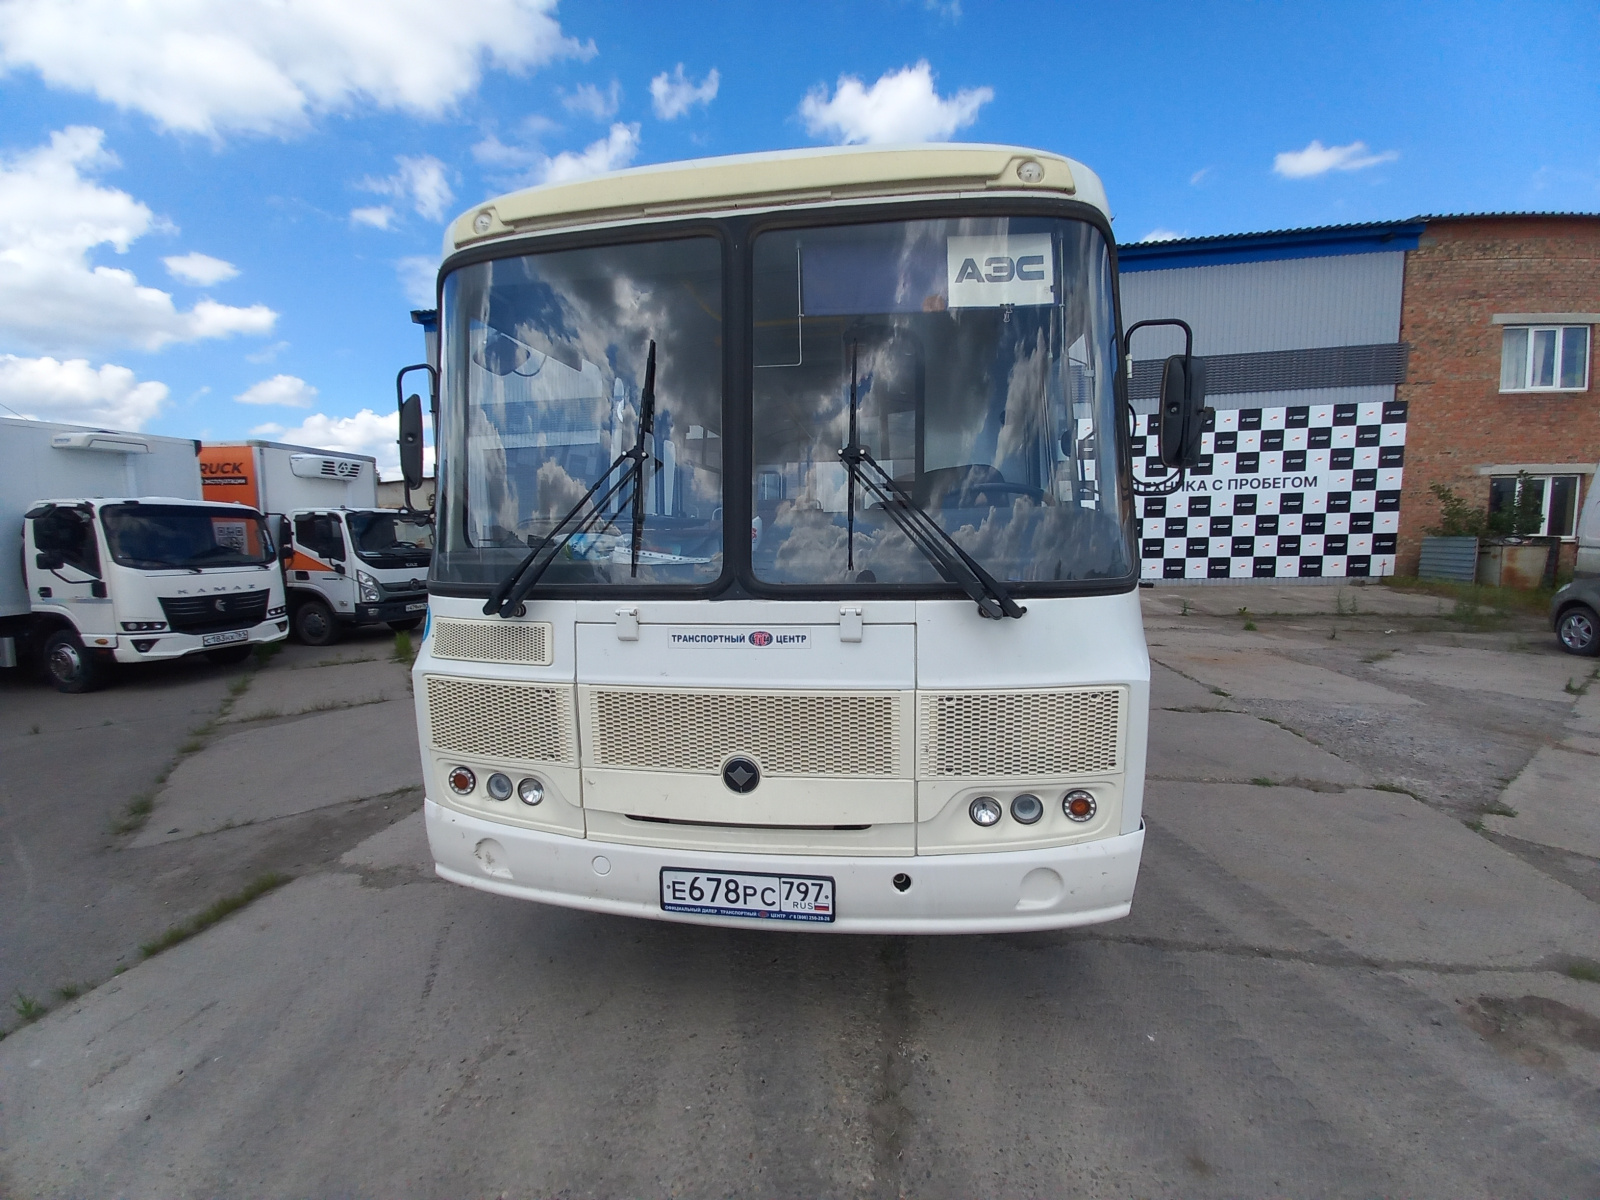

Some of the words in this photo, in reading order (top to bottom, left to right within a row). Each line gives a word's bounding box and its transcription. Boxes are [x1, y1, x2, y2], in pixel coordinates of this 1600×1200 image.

[955, 255, 1045, 283] АЭС
[1133, 479, 1208, 494] ТЕХНКА
[1212, 479, 1224, 492] С
[1227, 476, 1318, 490] ПРОБЕГОМ
[177, 584, 256, 595] KAMAZ
[671, 633, 746, 644] ТРАНСПОРТНЫЙ
[775, 634, 807, 645] ЦЕНТР
[672, 876, 777, 907] Е678РС
[782, 881, 825, 902] 797
[792, 902, 814, 911] RUS
